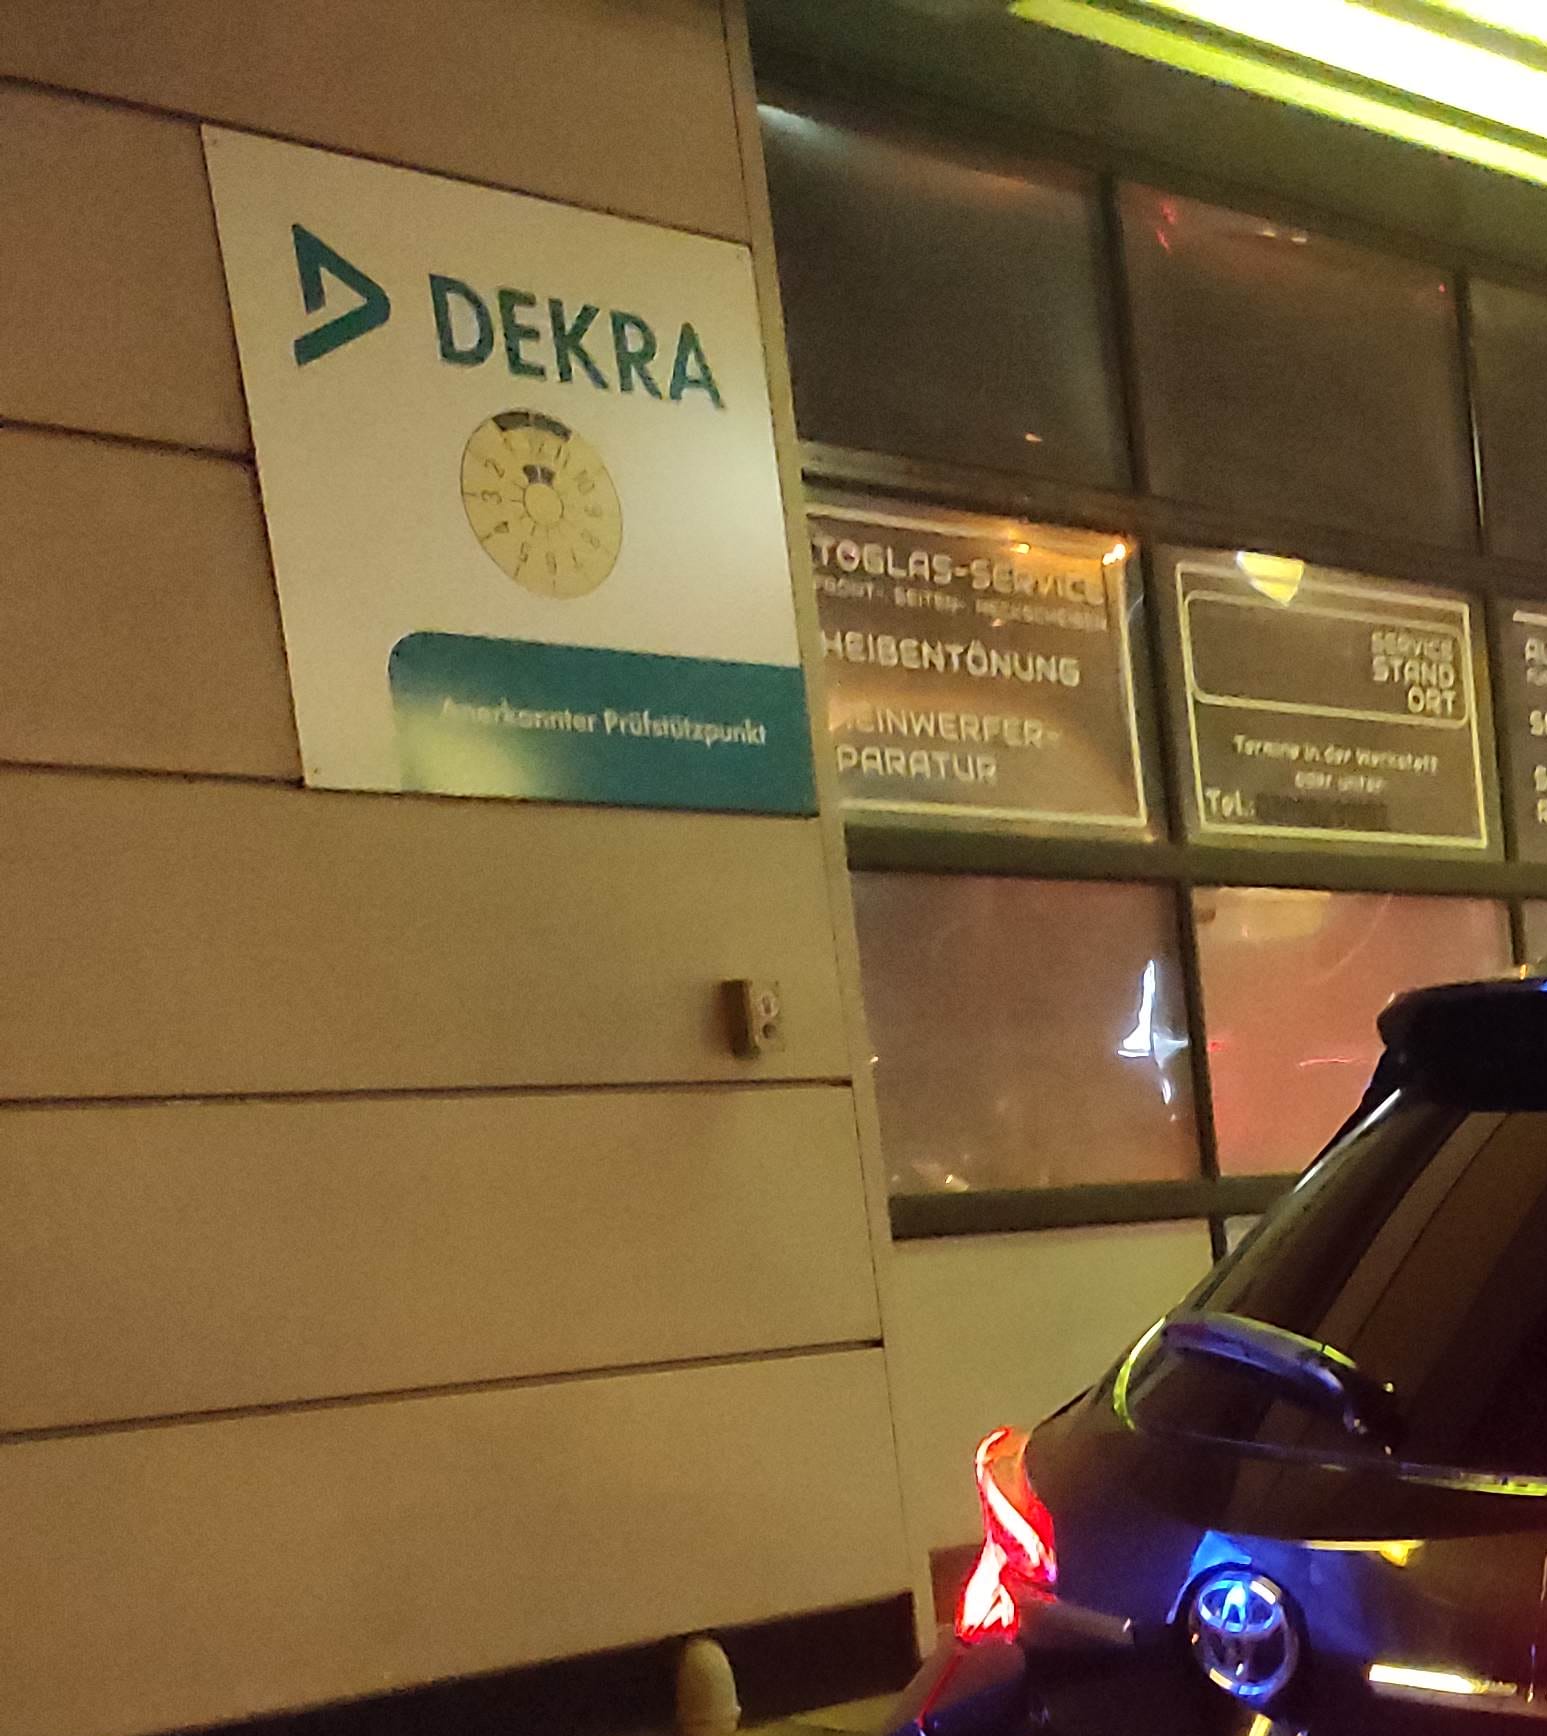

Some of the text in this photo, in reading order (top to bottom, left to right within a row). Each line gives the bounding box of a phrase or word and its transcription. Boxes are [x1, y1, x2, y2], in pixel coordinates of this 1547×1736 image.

[428, 273, 725, 409] DEKRA
[1371, 629, 1454, 662] SERVICE
[1371, 654, 1455, 689] STAND
[1406, 685, 1456, 715] ORT
[602, 707, 767, 747] Prüfstützpunkt
